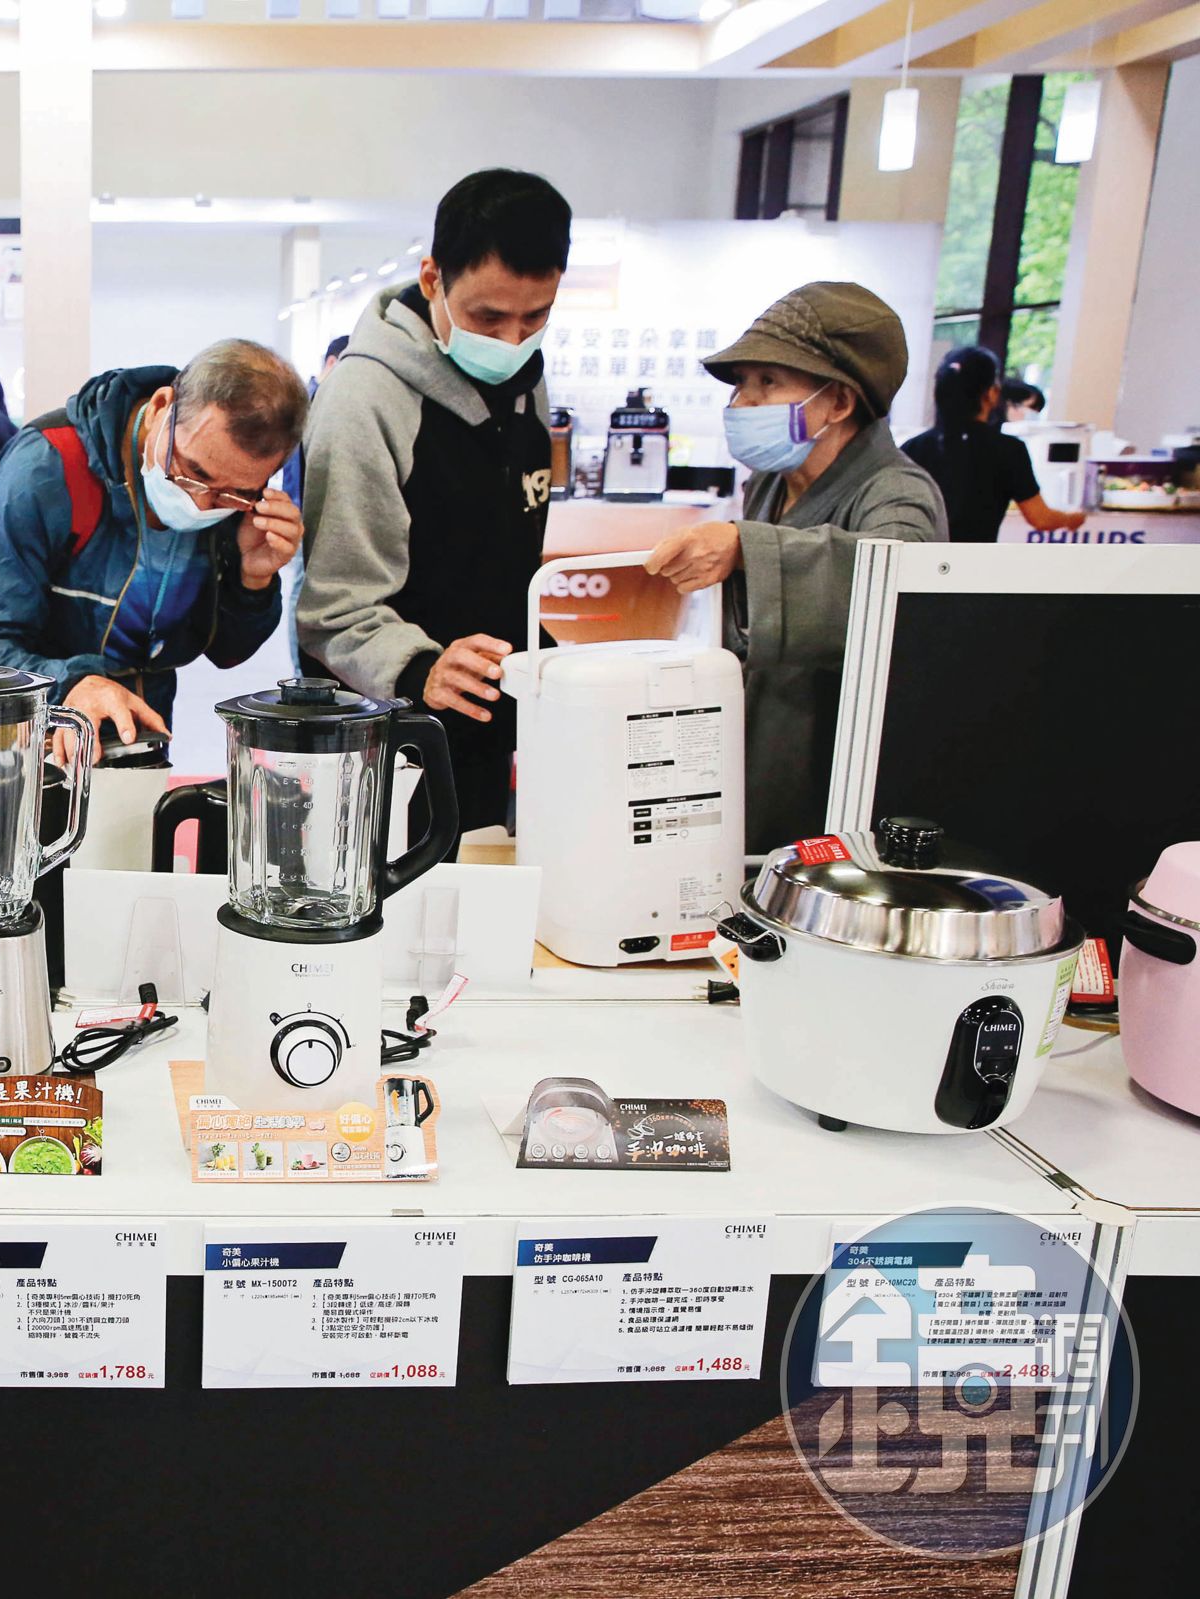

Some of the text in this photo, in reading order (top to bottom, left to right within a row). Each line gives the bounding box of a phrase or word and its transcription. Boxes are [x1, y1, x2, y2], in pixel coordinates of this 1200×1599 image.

[984, 1023, 1017, 1032] CHIMEI
[619, 1103, 648, 1111] CHIMEI
[724, 1224, 767, 1234] CHIMEI
[114, 1232, 157, 1242] CHIMEI
[413, 1231, 456, 1241] CHIMEI
[1039, 1232, 1083, 1241] CHIMEI
[221, 1247, 242, 1257] 奇美
[534, 1243, 554, 1253] 奇美
[849, 1246, 869, 1255] 奇美
[221, 1257, 280, 1267] 小偏心果汁機
[534, 1253, 592, 1264] 仿手沖咖啡機
[622, 1272, 664, 1282] 產品特點
[934, 1277, 976, 1287] 產品特點
[15, 1278, 57, 1288] 產品特點
[251, 1279, 298, 1288] MX-1500T2
[312, 1278, 354, 1288] 產品特點
[617, 1365, 641, 1373] 市售價
[696, 1357, 743, 1374] 1,488
[20, 1371, 44, 1379] 市售價
[99, 1365, 146, 1381] 1,788
[311, 1371, 336, 1379] 市售價
[391, 1364, 438, 1380] 1,088
[1002, 1364, 1050, 1379] 2,488
